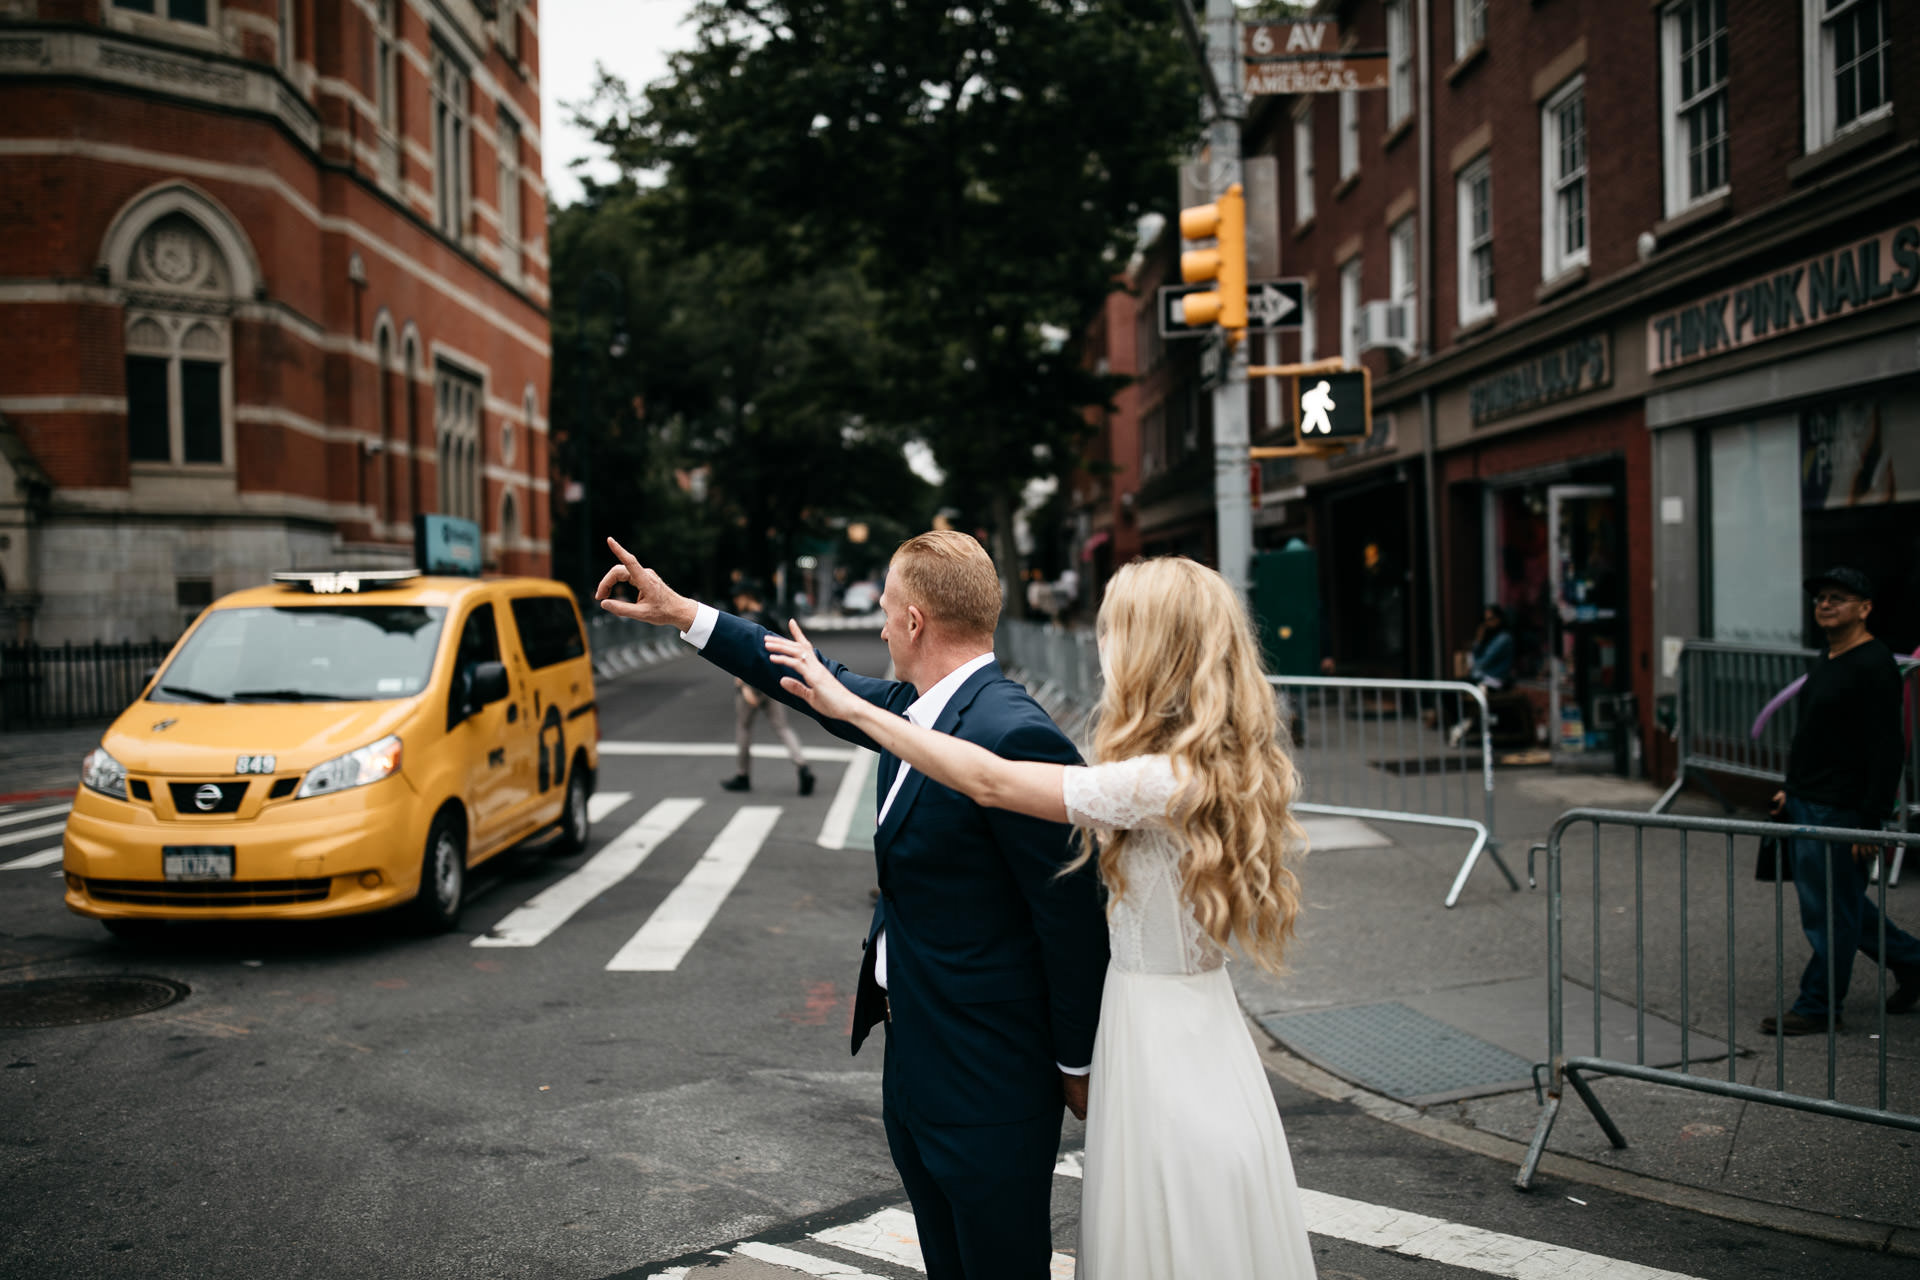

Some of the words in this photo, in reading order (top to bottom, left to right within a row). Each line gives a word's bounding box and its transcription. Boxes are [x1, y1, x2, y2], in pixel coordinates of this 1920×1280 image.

[1253, 27, 1274, 53] 6
[1286, 23, 1326, 51] AV
[1247, 70, 1359, 93] AMERICAS
[1655, 294, 1731, 366] THINK
[1733, 267, 1804, 342] PINK
[1808, 225, 1920, 320] NAILS
[236, 754, 275, 774] 849
